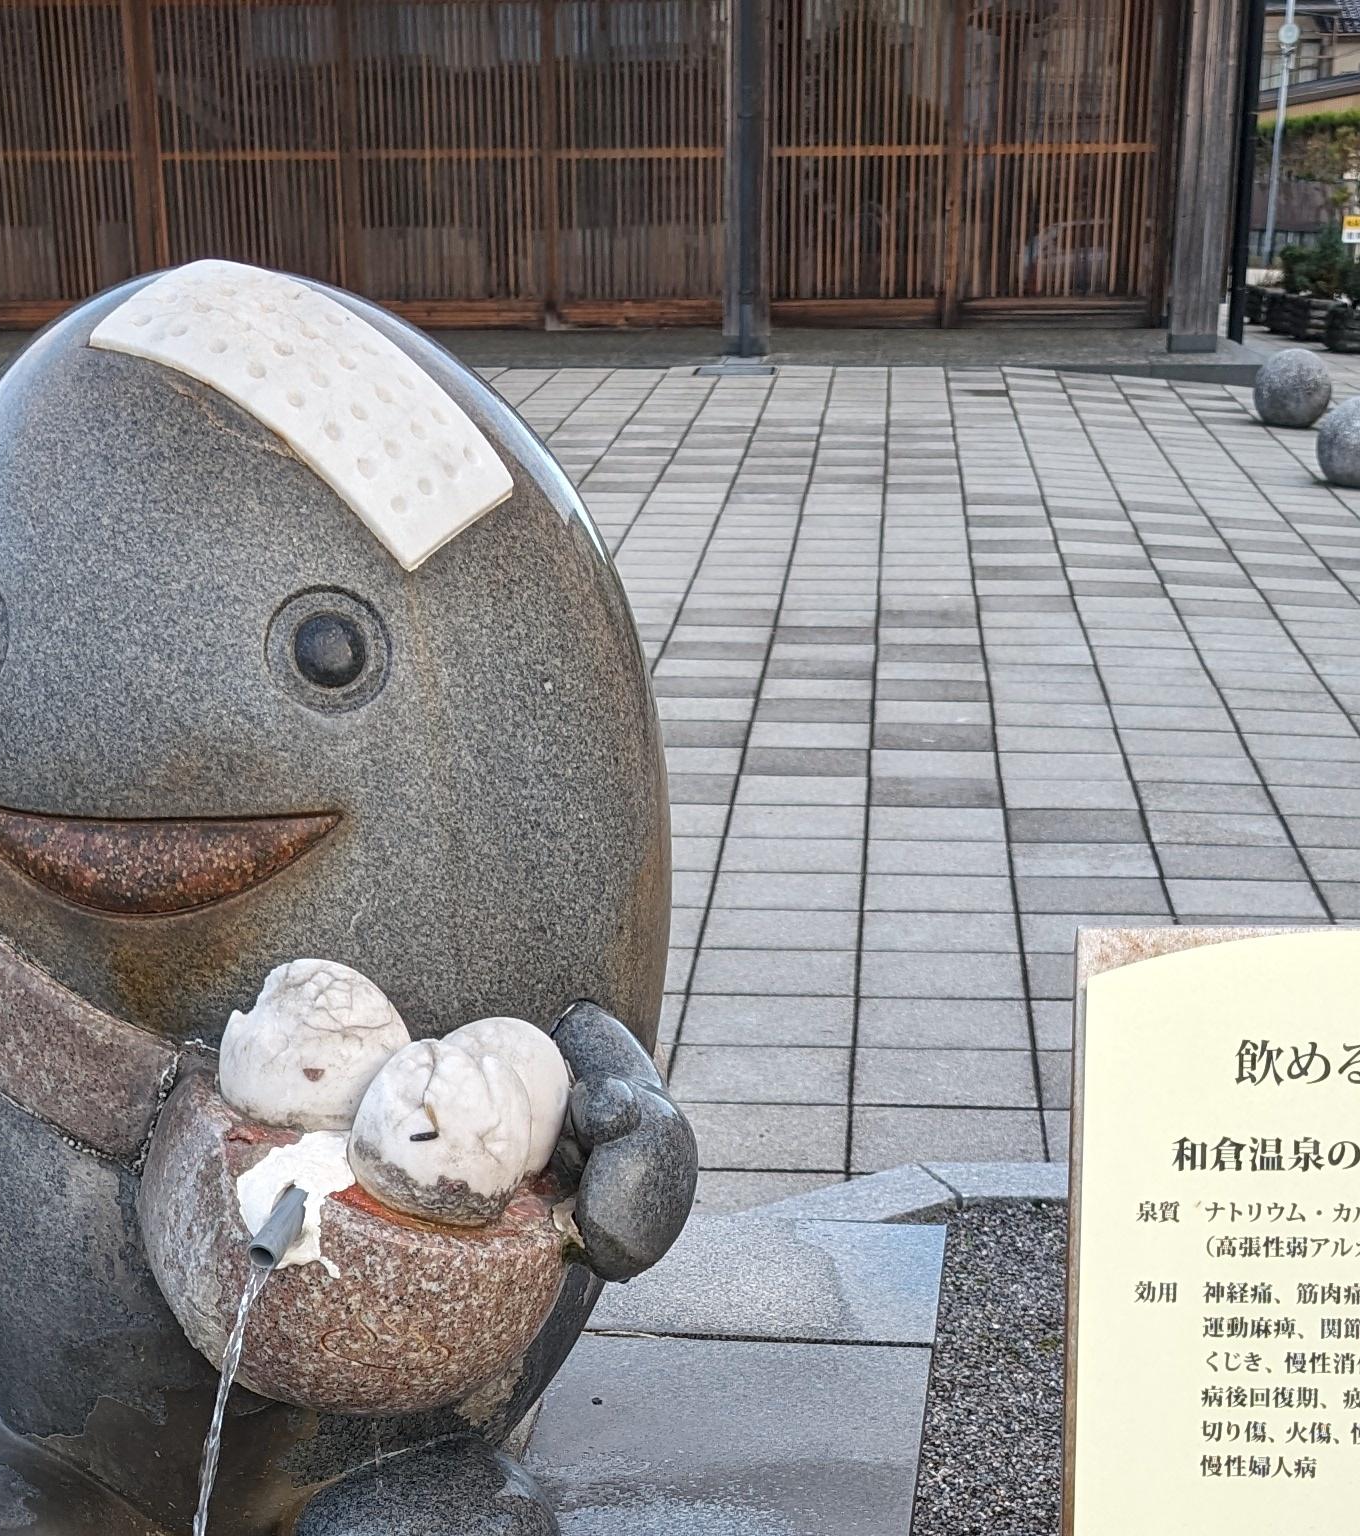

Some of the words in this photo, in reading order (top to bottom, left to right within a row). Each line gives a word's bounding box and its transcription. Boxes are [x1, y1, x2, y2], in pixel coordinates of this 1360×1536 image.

[1135, 1200, 1181, 1224] 泉質
[1133, 1280, 1178, 1304] 効用
[1199, 1454, 1318, 1479] 慢性婦人病
